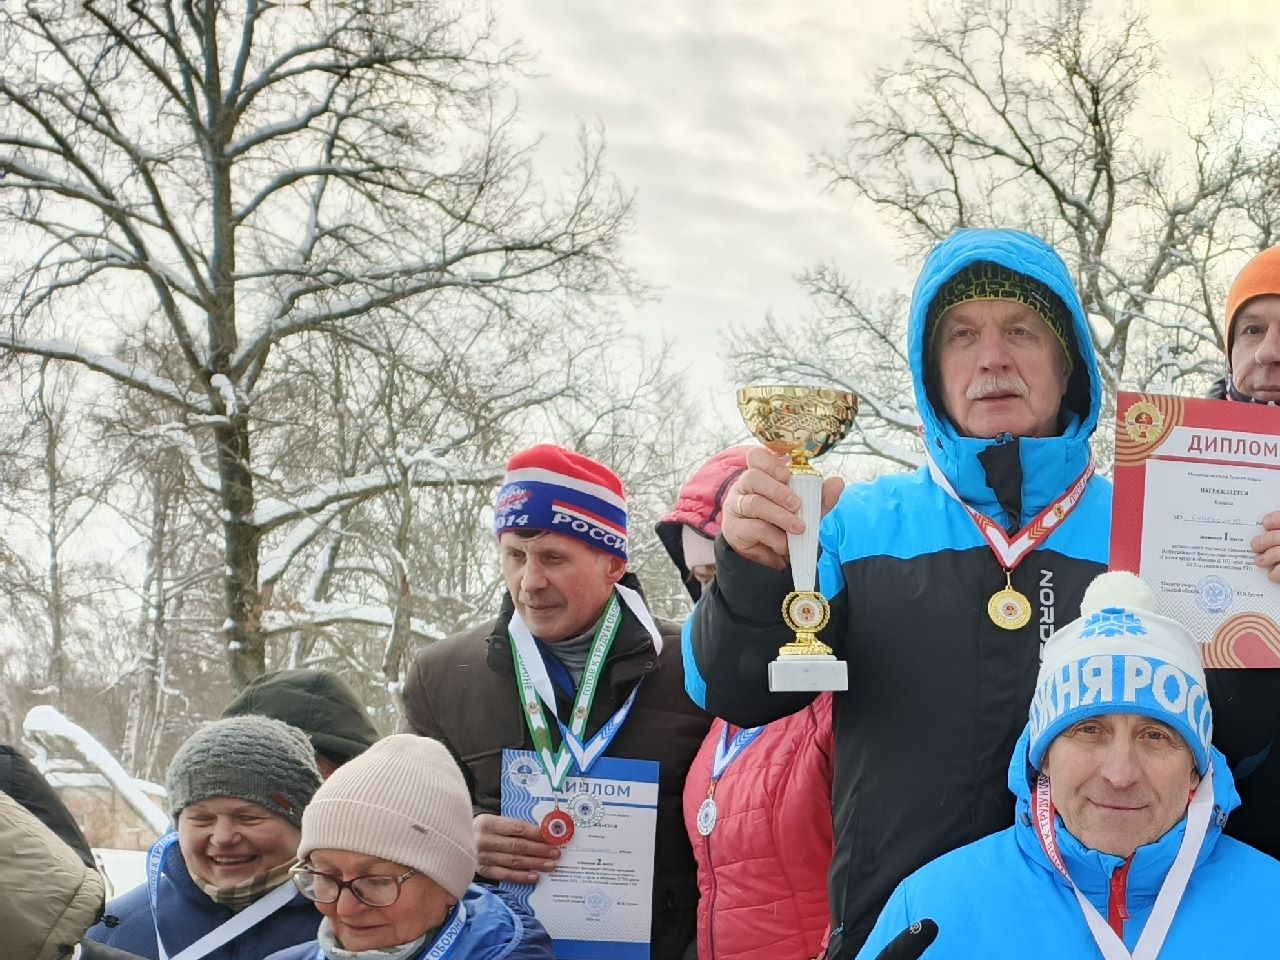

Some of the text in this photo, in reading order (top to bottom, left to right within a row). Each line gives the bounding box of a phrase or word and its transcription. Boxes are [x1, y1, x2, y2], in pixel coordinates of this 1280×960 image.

[1188, 434, 1278, 458] ДИПЛОМ
[1039, 569, 1055, 662] NORD
[583, 669, 596, 696] ГОТОВ
